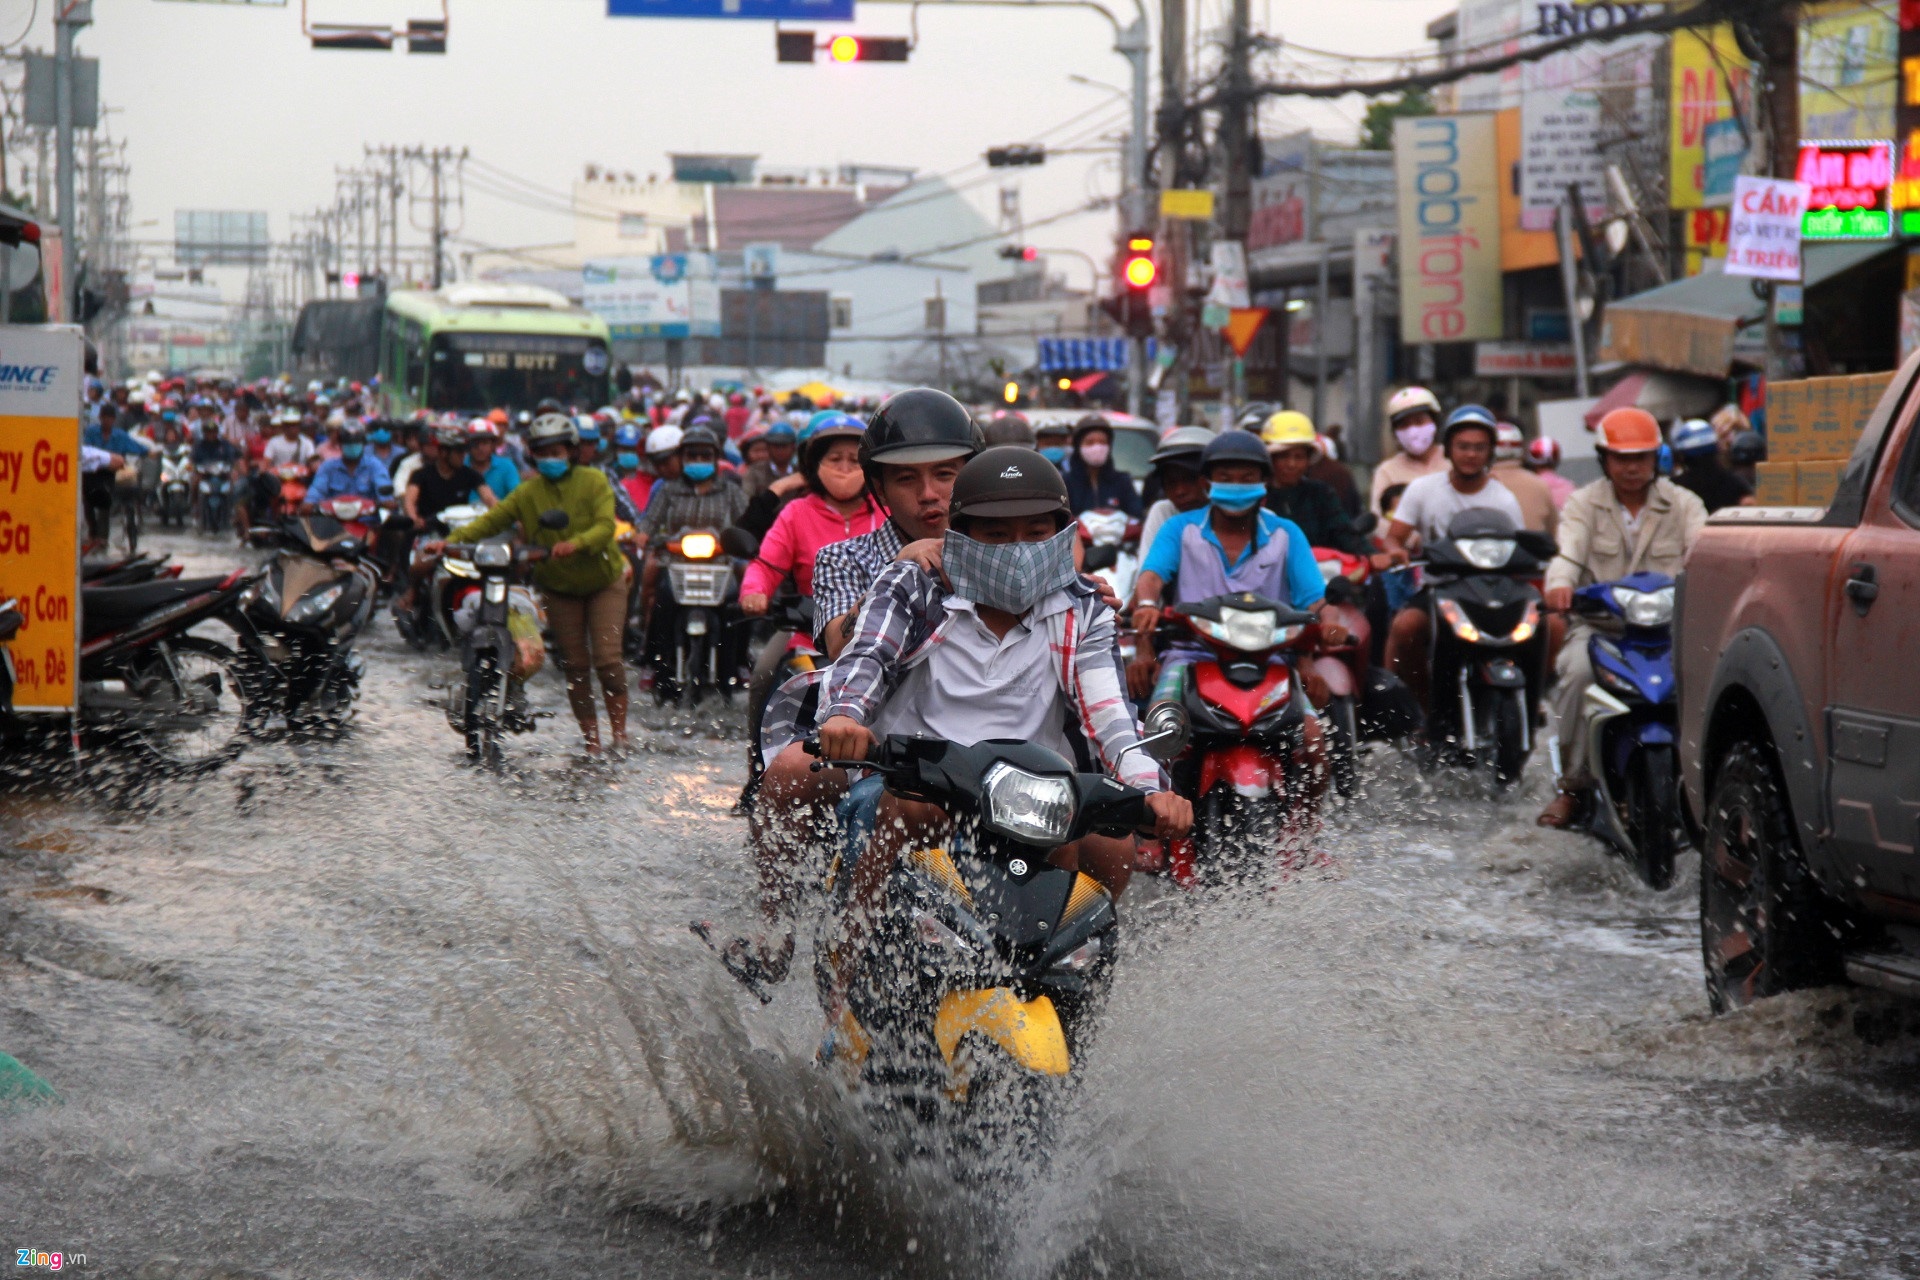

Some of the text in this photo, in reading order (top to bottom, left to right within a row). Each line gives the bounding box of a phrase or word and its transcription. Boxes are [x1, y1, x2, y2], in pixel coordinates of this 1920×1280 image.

[1415, 118, 1479, 339] mobifone
[33, 438, 69, 483] Ga
[0, 510, 30, 554] Ga
[36, 584, 68, 622] Con
